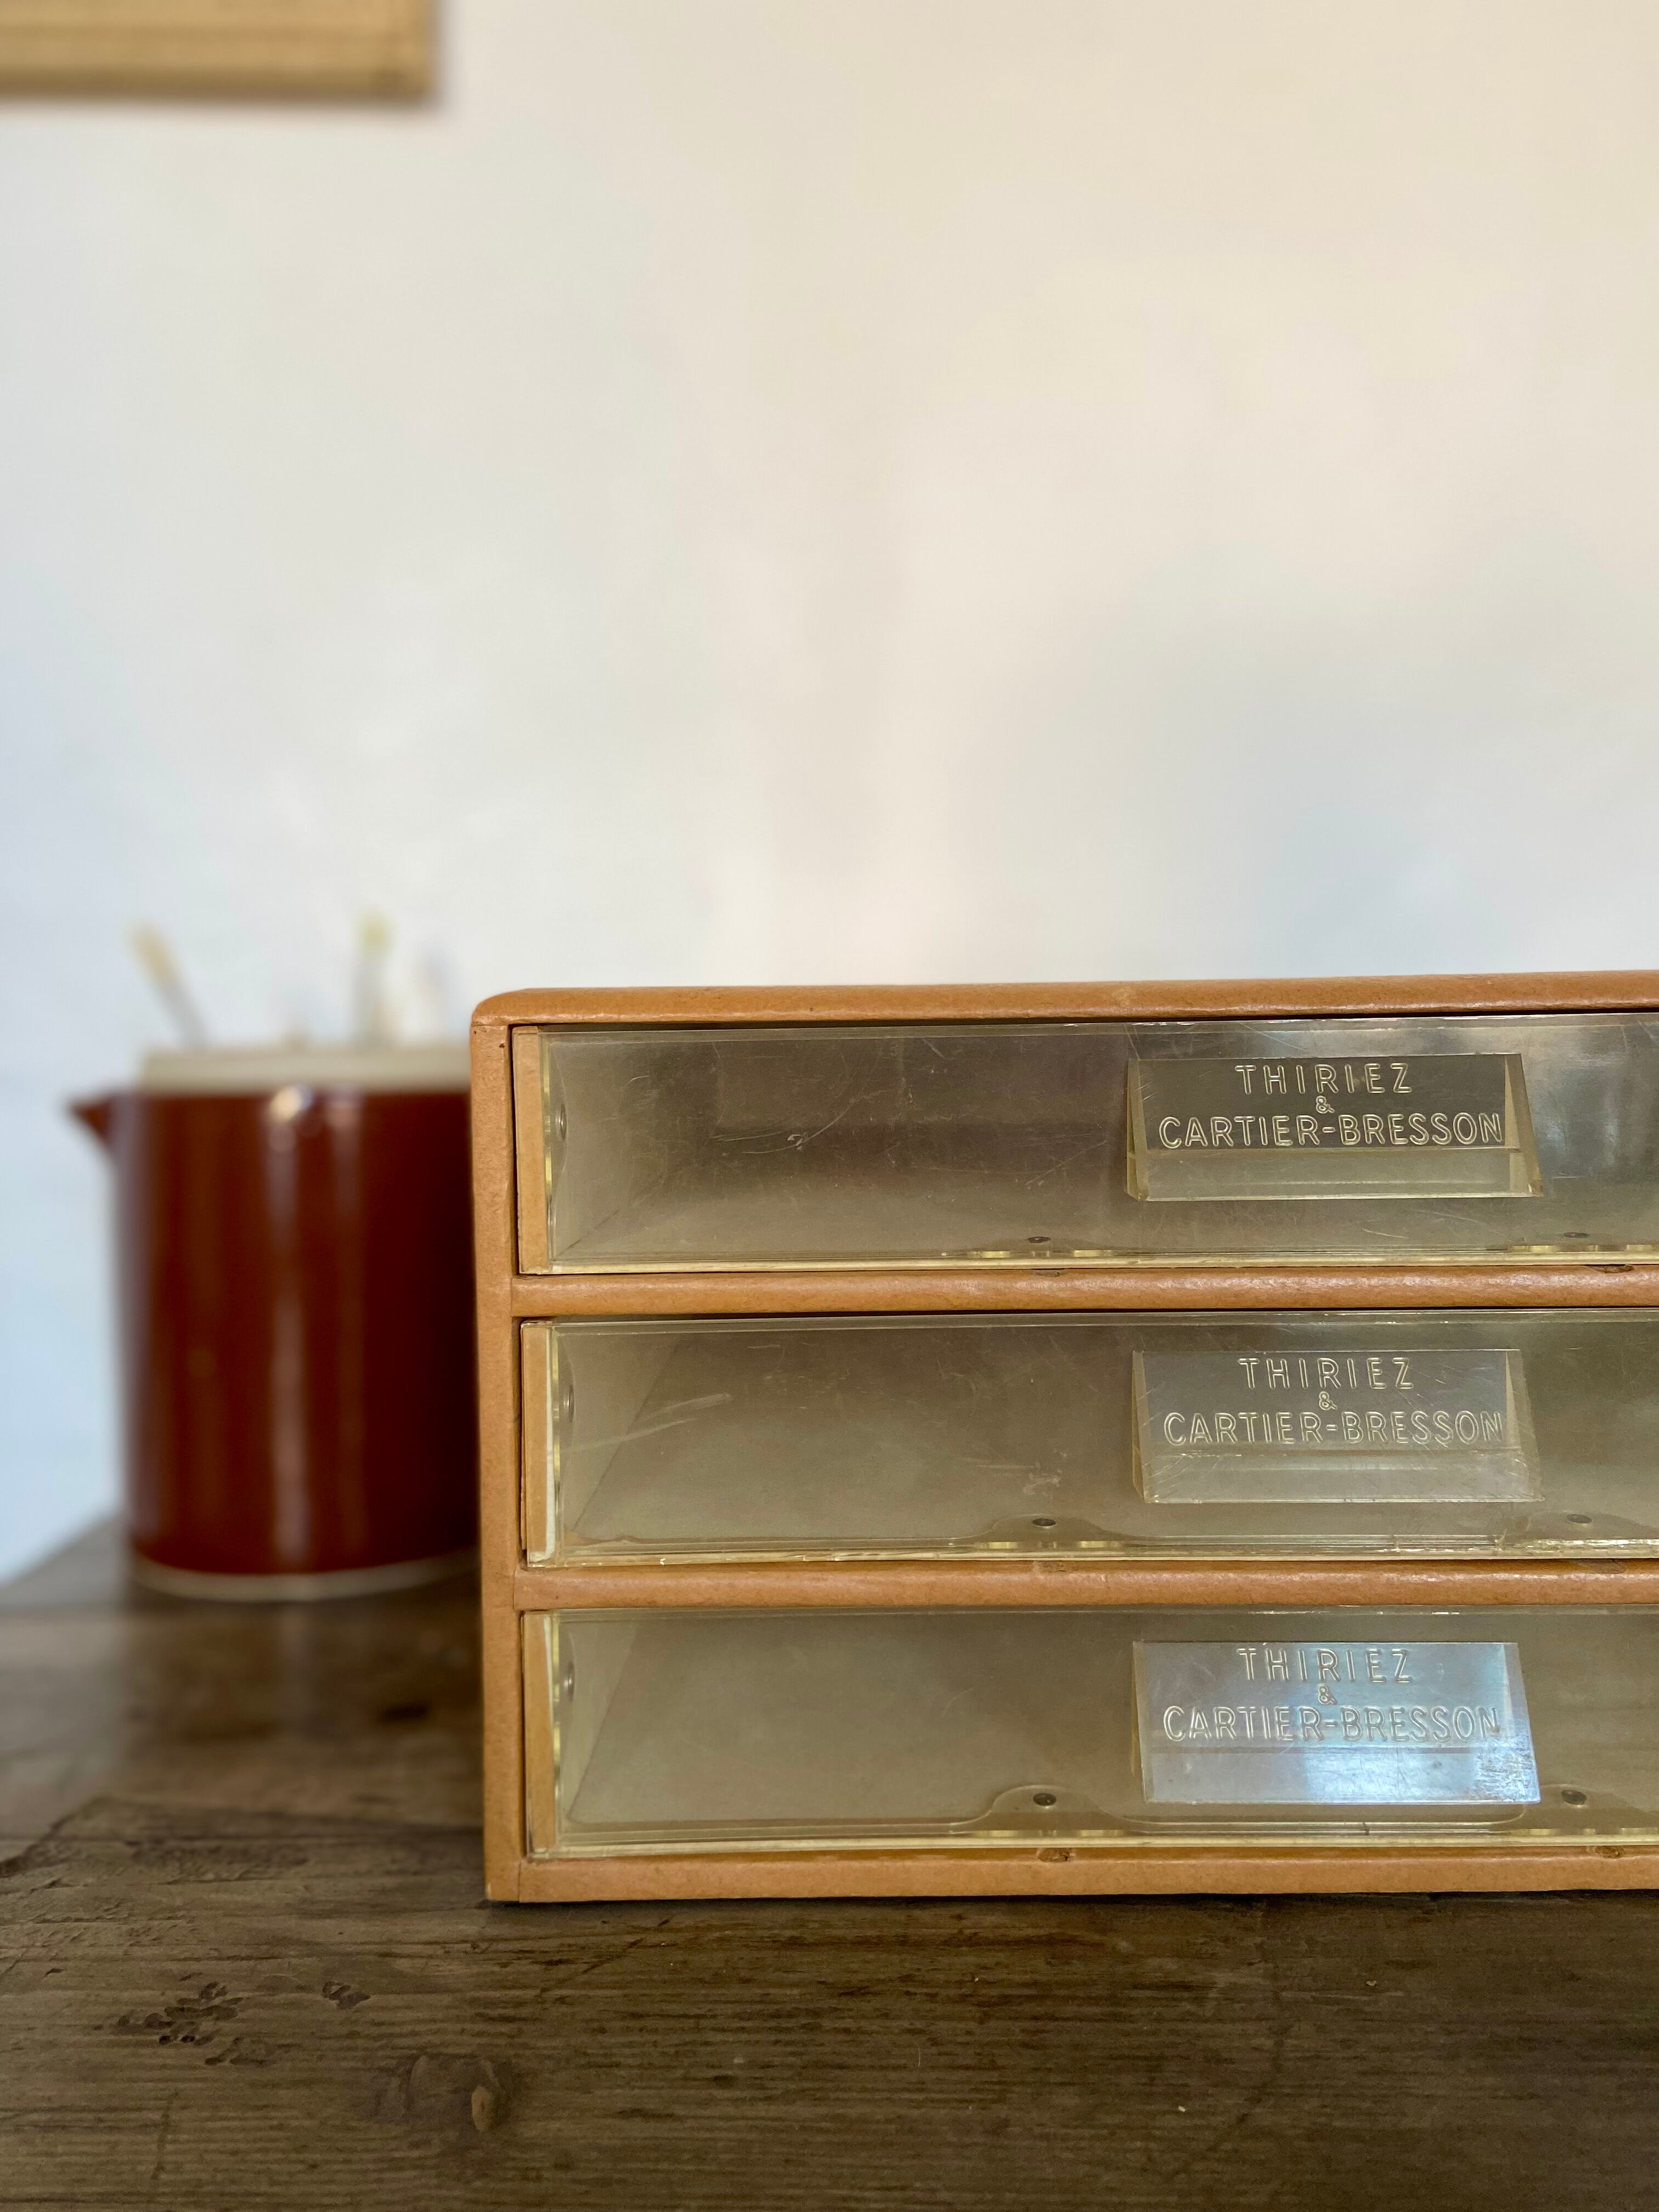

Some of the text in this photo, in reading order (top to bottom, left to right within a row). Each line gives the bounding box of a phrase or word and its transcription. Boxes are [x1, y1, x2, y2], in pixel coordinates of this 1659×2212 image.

[1234, 1062, 1413, 1095] THIRIEZ
[1315, 1095, 1335, 1114] &
[1158, 1112, 1503, 1149] CARTIER-BRESSON
[1238, 1356, 1414, 1390] THIRIEZ
[1318, 1391, 1339, 1411] &
[1163, 1410, 1503, 1447] CARTIER-BRESSON
[1238, 1647, 1414, 1683] THIRIEZ
[1317, 1684, 1338, 1706] &
[1163, 1705, 1502, 1743] CARTIER-BRESSON
